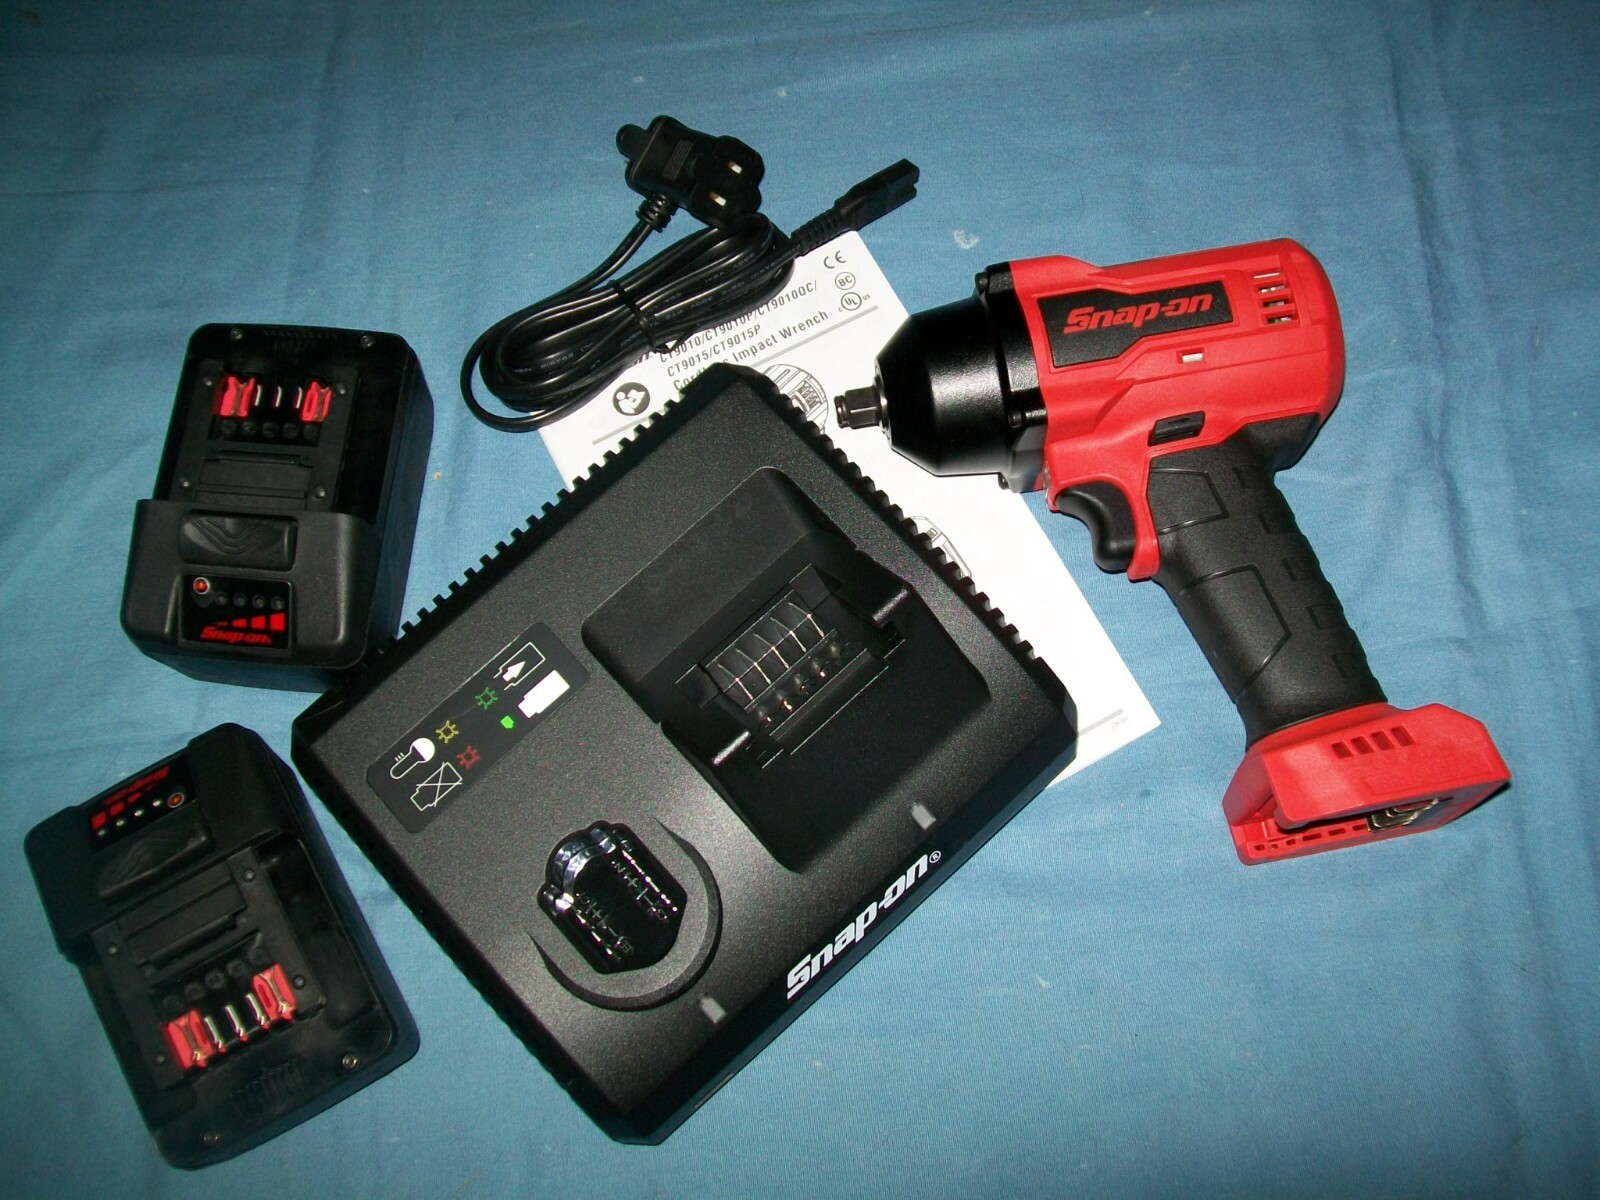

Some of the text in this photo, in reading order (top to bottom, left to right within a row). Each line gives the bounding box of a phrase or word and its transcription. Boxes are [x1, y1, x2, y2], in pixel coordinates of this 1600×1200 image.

[732, 334, 778, 363] Impact
[778, 310, 829, 340] Wrench
[1063, 293, 1213, 335] Snap-on
[666, 324, 761, 377] CT9015/CT9015P
